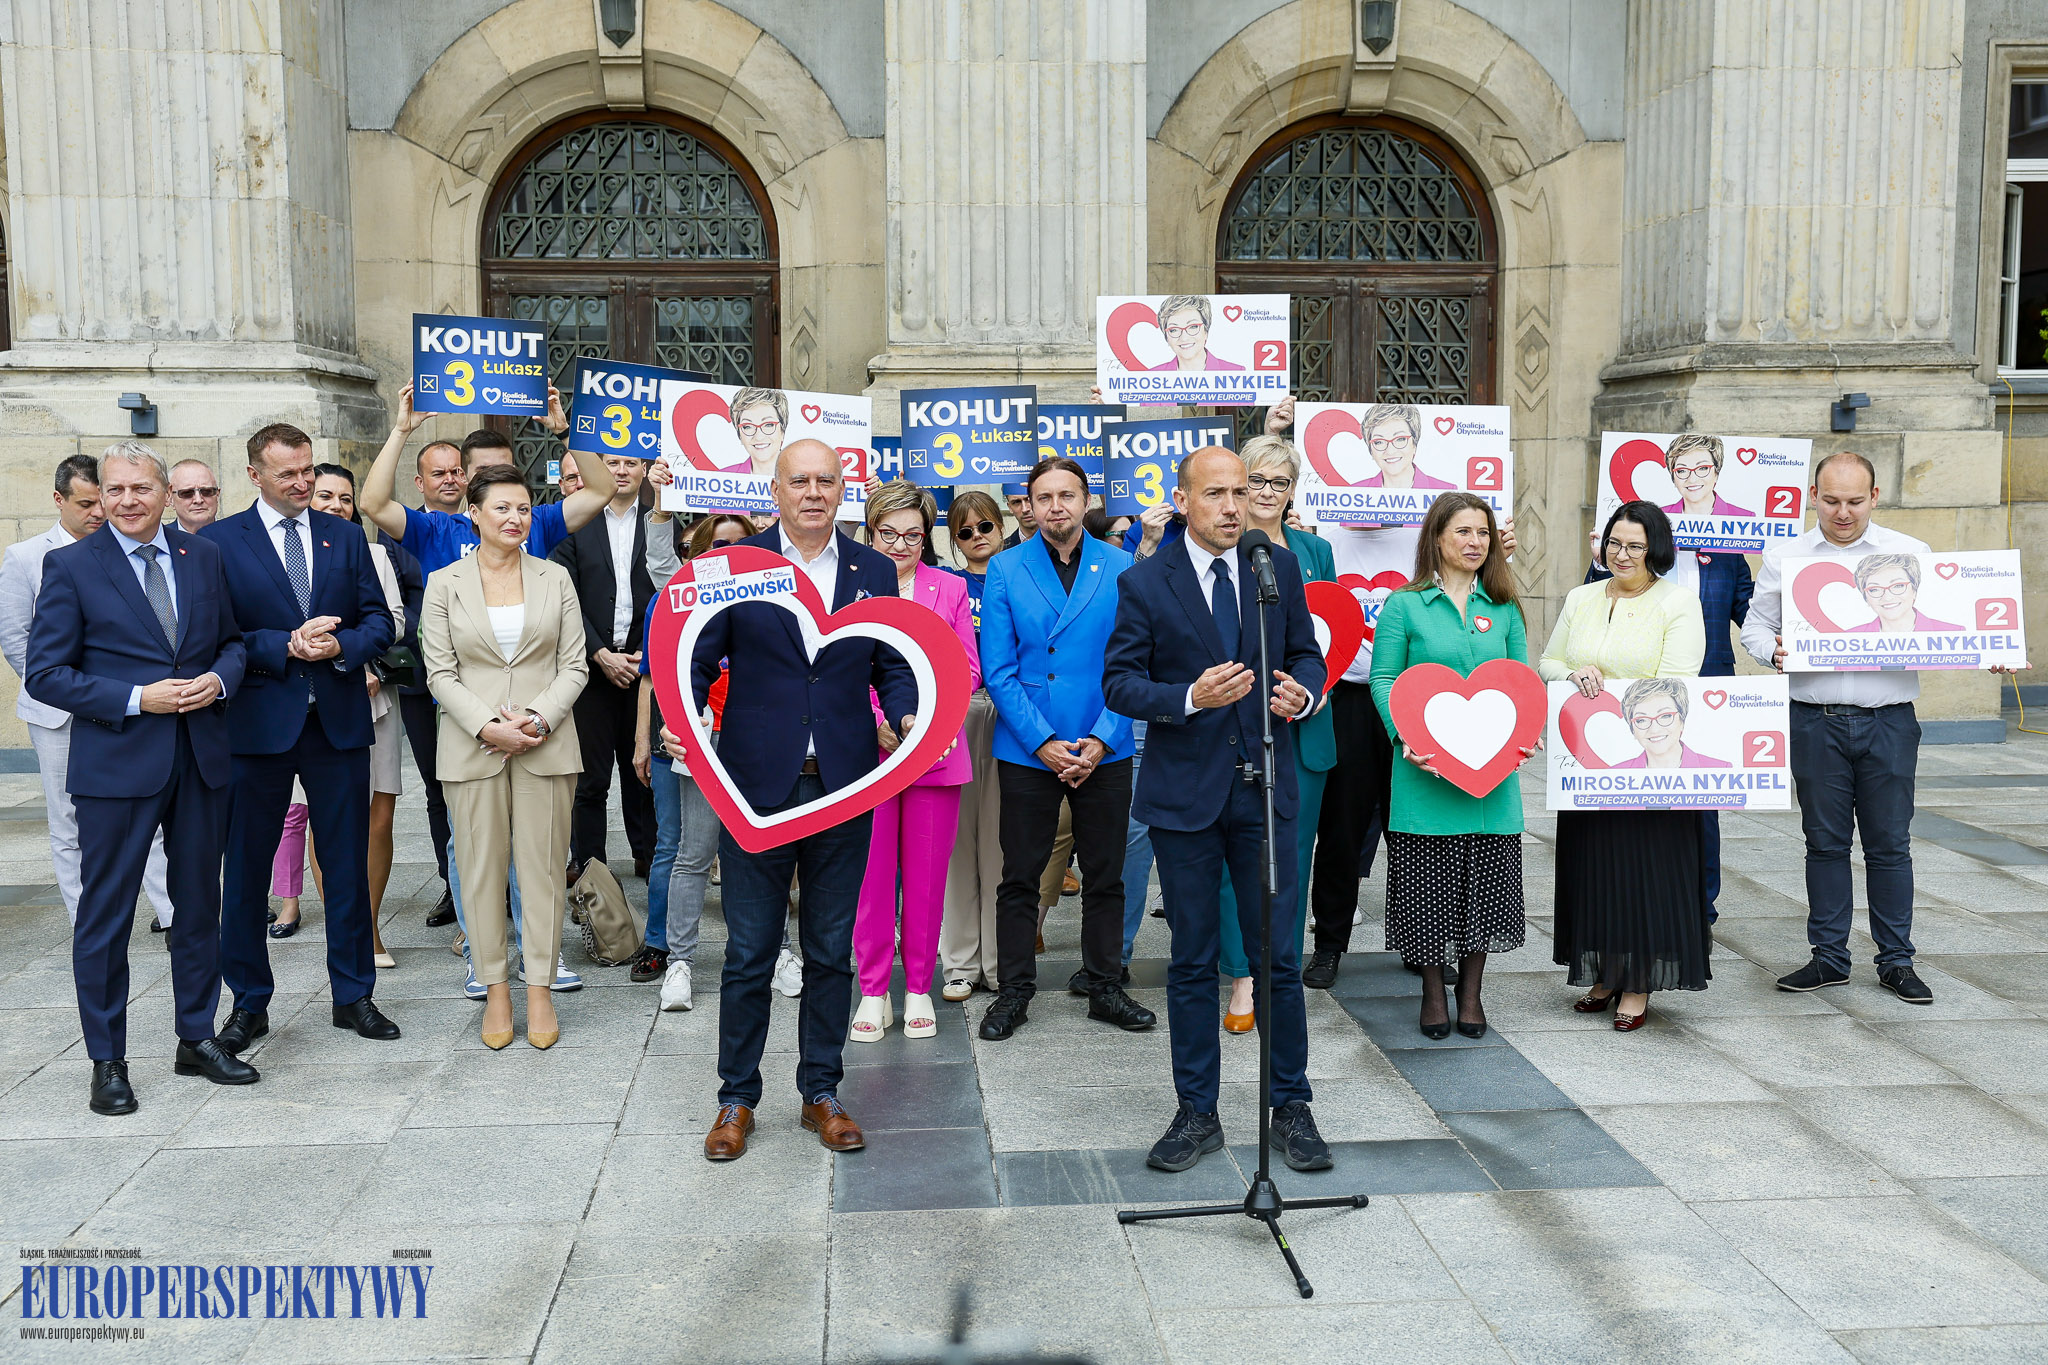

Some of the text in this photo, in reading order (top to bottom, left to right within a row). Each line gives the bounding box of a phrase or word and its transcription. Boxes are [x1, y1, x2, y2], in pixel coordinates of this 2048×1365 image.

[1244, 314, 1286, 322] Obywatelska
[420, 326, 544, 358] KOHUT
[1260, 344, 1280, 367] 2
[482, 360, 543, 376] Łukasz
[444, 360, 476, 406] 3
[581, 370, 661, 403] KOH
[1109, 376, 1286, 390] MIROSŁAWA NYKIEL
[822, 410, 850, 420] Koalicja
[908, 398, 1032, 428] KOHUT
[600, 404, 632, 448] 3
[822, 416, 868, 427] Obywatelska
[1038, 416, 1123, 440] OHU
[970, 428, 1032, 444] Łukasz
[1456, 428, 1504, 436] Obywatelska
[1066, 443, 1104, 457] Łuka
[1109, 428, 1230, 459] KOHUT
[932, 432, 964, 478] 3
[1758, 458, 1804, 467] Obywatelska
[840, 452, 859, 477] 2
[1474, 461, 1495, 486] 2
[674, 476, 772, 496] MIROSŁAW
[1134, 462, 1165, 508] 3
[689, 496, 744, 508] BEZPIECZNA
[1306, 492, 1416, 508] MIROSŁAWA
[1772, 490, 1794, 514] 2
[1320, 512, 1424, 522] BEZPIECZNA POLSKA W
[1722, 521, 1798, 537] NYKIEL
[1676, 538, 1762, 548] POLSKA W EUROPIE
[1961, 565, 1994, 574] Koalicja
[1961, 571, 2016, 580] Obywatelska
[698, 578, 736, 591] Krzysztof
[700, 578, 794, 605] GADOWSKI
[672, 586, 698, 610] 10
[1984, 602, 2008, 626] 2
[1796, 636, 2019, 652] MIROSŁAWA NYKIEL
[1812, 654, 1976, 664] BEZPIECZNA POLSKA W EUROPIE
[1729, 694, 1762, 702] Koalicja
[1729, 700, 1784, 708] Obywatelska
[1752, 736, 1776, 763] 2
[1562, 774, 1786, 790] MIROSŁAWA NYKIEL
[1578, 796, 1742, 804] BEZPIECZNA POLSKA W EUROPIE
